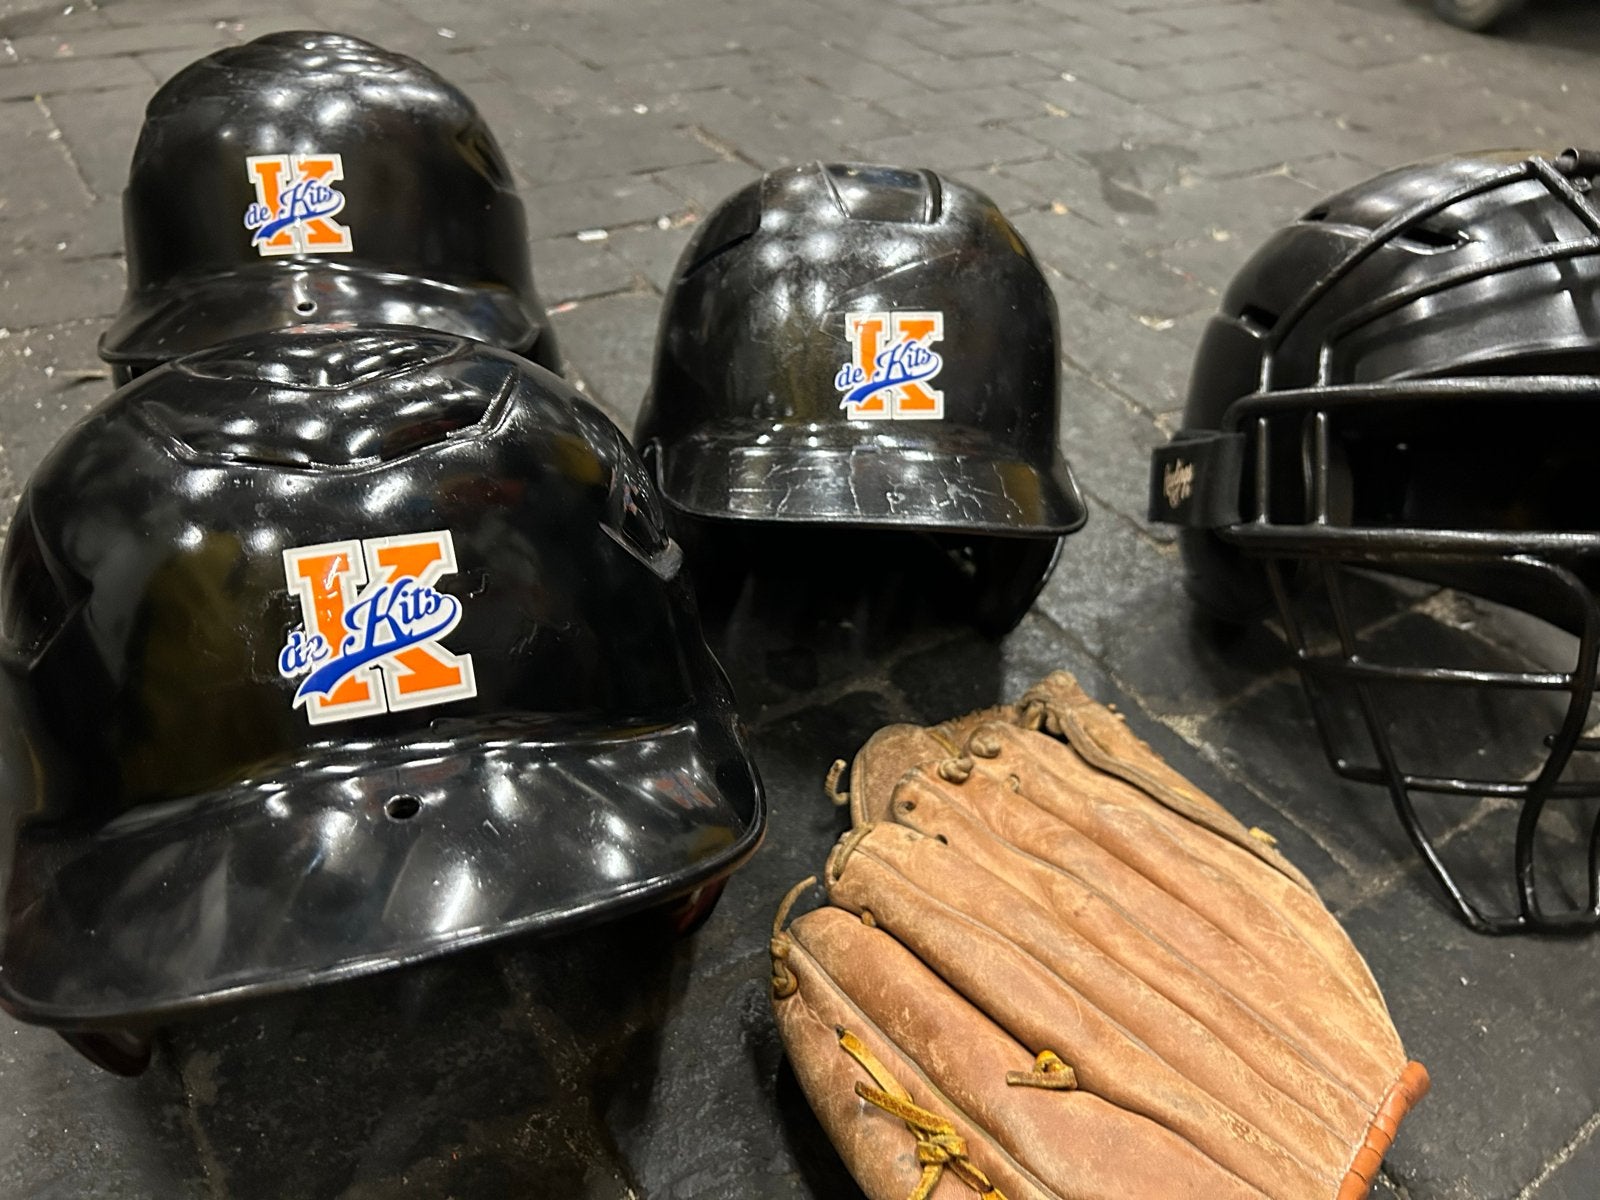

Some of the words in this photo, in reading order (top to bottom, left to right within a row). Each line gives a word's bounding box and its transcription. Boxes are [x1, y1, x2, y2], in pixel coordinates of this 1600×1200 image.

[246, 204, 269, 227] de
[276, 179, 342, 222] Kits
[246, 153, 353, 256] K
[837, 365, 863, 388] de
[868, 340, 940, 386] Kits
[845, 311, 944, 420] K
[281, 631, 328, 673] de
[336, 577, 457, 664] Kits
[283, 530, 477, 725] K
